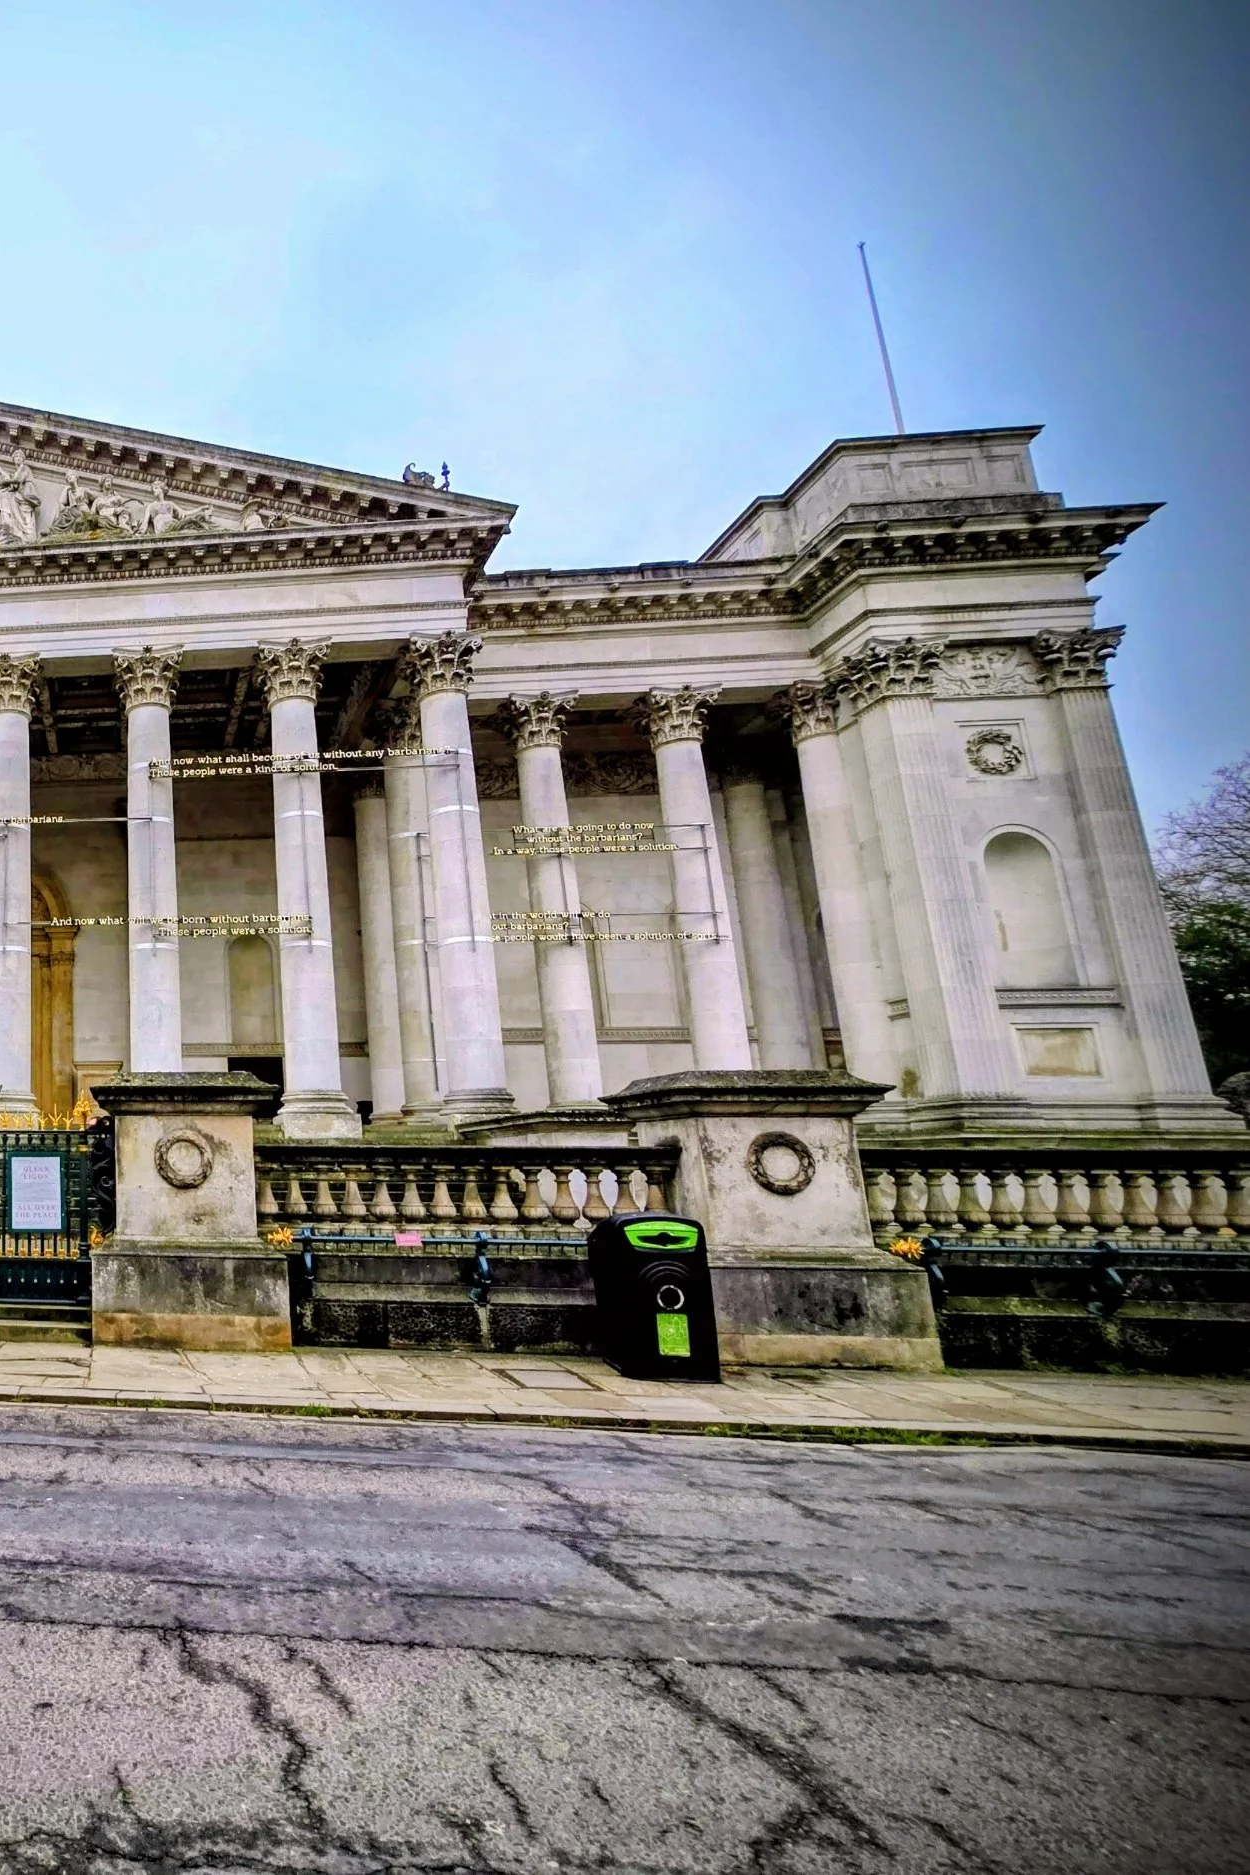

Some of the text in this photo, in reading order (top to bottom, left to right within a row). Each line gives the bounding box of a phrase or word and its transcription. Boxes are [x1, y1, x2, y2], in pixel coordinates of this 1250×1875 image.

[150, 757, 170, 766] And
[198, 756, 222, 764] what
[226, 754, 249, 763] shall
[294, 751, 305, 760] of
[323, 750, 362, 758] without
[366, 750, 384, 760] any
[150, 768, 180, 776] Those
[183, 768, 216, 778] people
[219, 766, 242, 774] were
[254, 764, 276, 773] kind
[280, 764, 292, 772] of
[512, 826, 539, 834] What
[576, 824, 604, 834] going
[526, 834, 564, 842] without
[584, 832, 642, 842] barbarians?
[494, 846, 505, 855] In
[568, 844, 600, 854] people
[51, 916, 72, 926] And
[98, 916, 124, 926] what
[128, 916, 146, 924] will
[167, 915, 179, 924] be
[182, 914, 206, 924] born
[210, 914, 250, 924] without
[512, 911, 527, 919] the
[530, 910, 558, 919] world
[561, 910, 578, 918] will
[598, 910, 610, 918] do
[510, 922, 569, 930] barbarians?
[158, 927, 190, 936] These
[193, 926, 227, 938] people
[231, 927, 256, 935] were
[504, 933, 536, 944] people
[538, 932, 568, 940] would
[572, 932, 595, 940] have
[598, 931, 622, 940] been
[635, 931, 674, 940] solution
[678, 931, 688, 940] of
